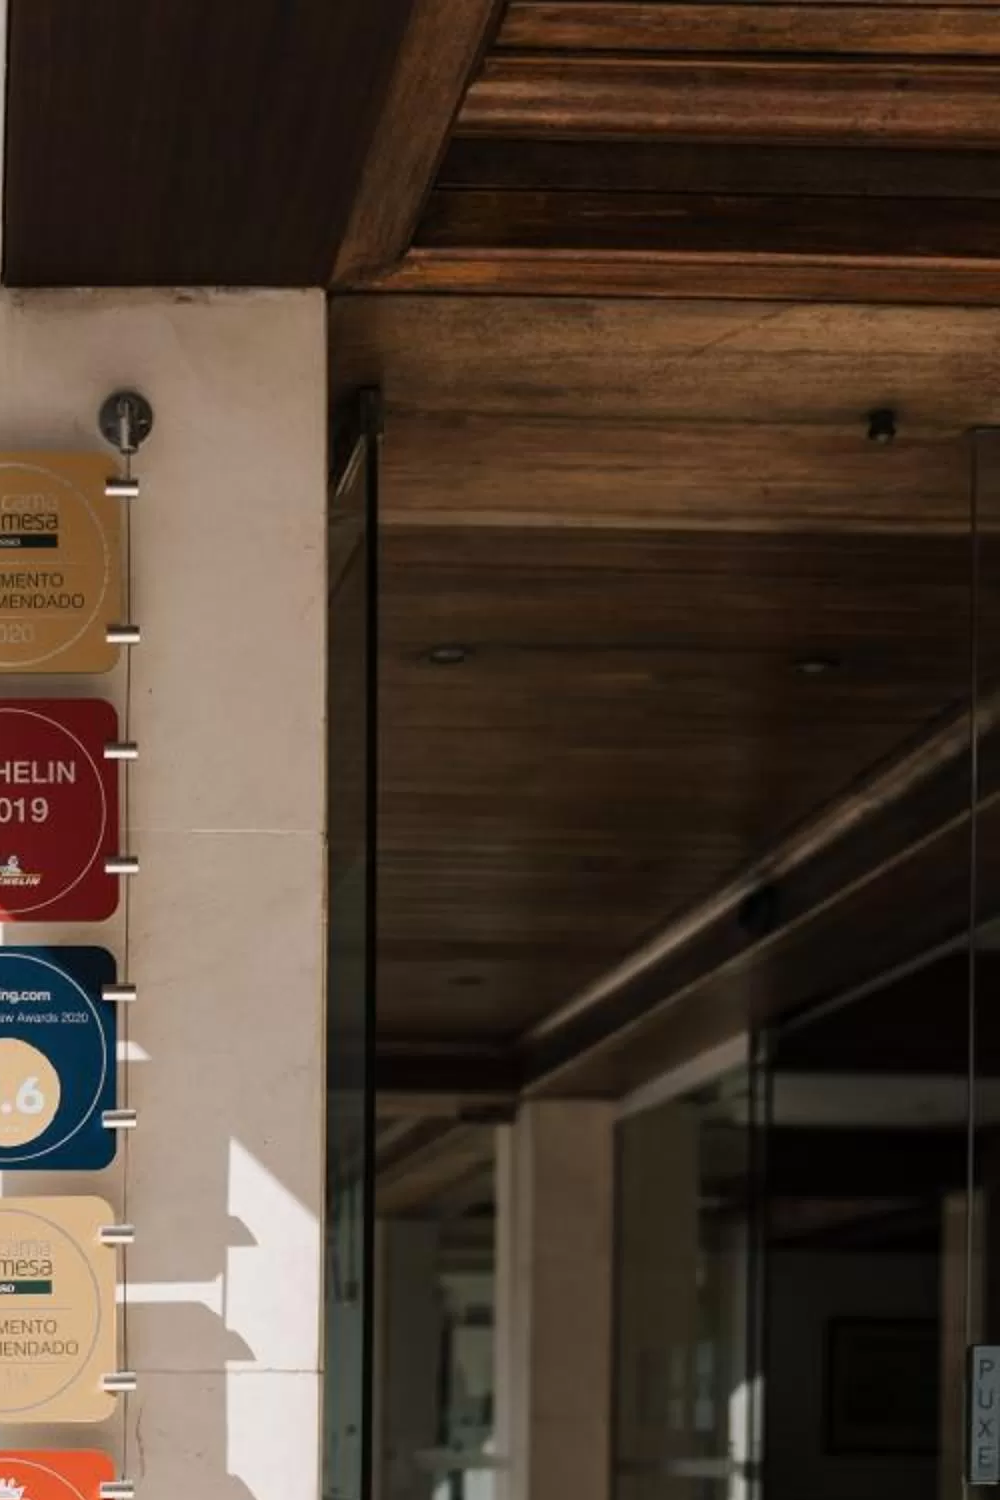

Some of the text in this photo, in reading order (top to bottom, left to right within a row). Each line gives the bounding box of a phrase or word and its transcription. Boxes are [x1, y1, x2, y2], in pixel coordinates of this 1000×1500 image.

[1, 513, 58, 531] mesa
[17, 1011, 59, 1023] Awards
[61, 1011, 89, 1023] 2020
[977, 1358, 995, 1468] PUXE
